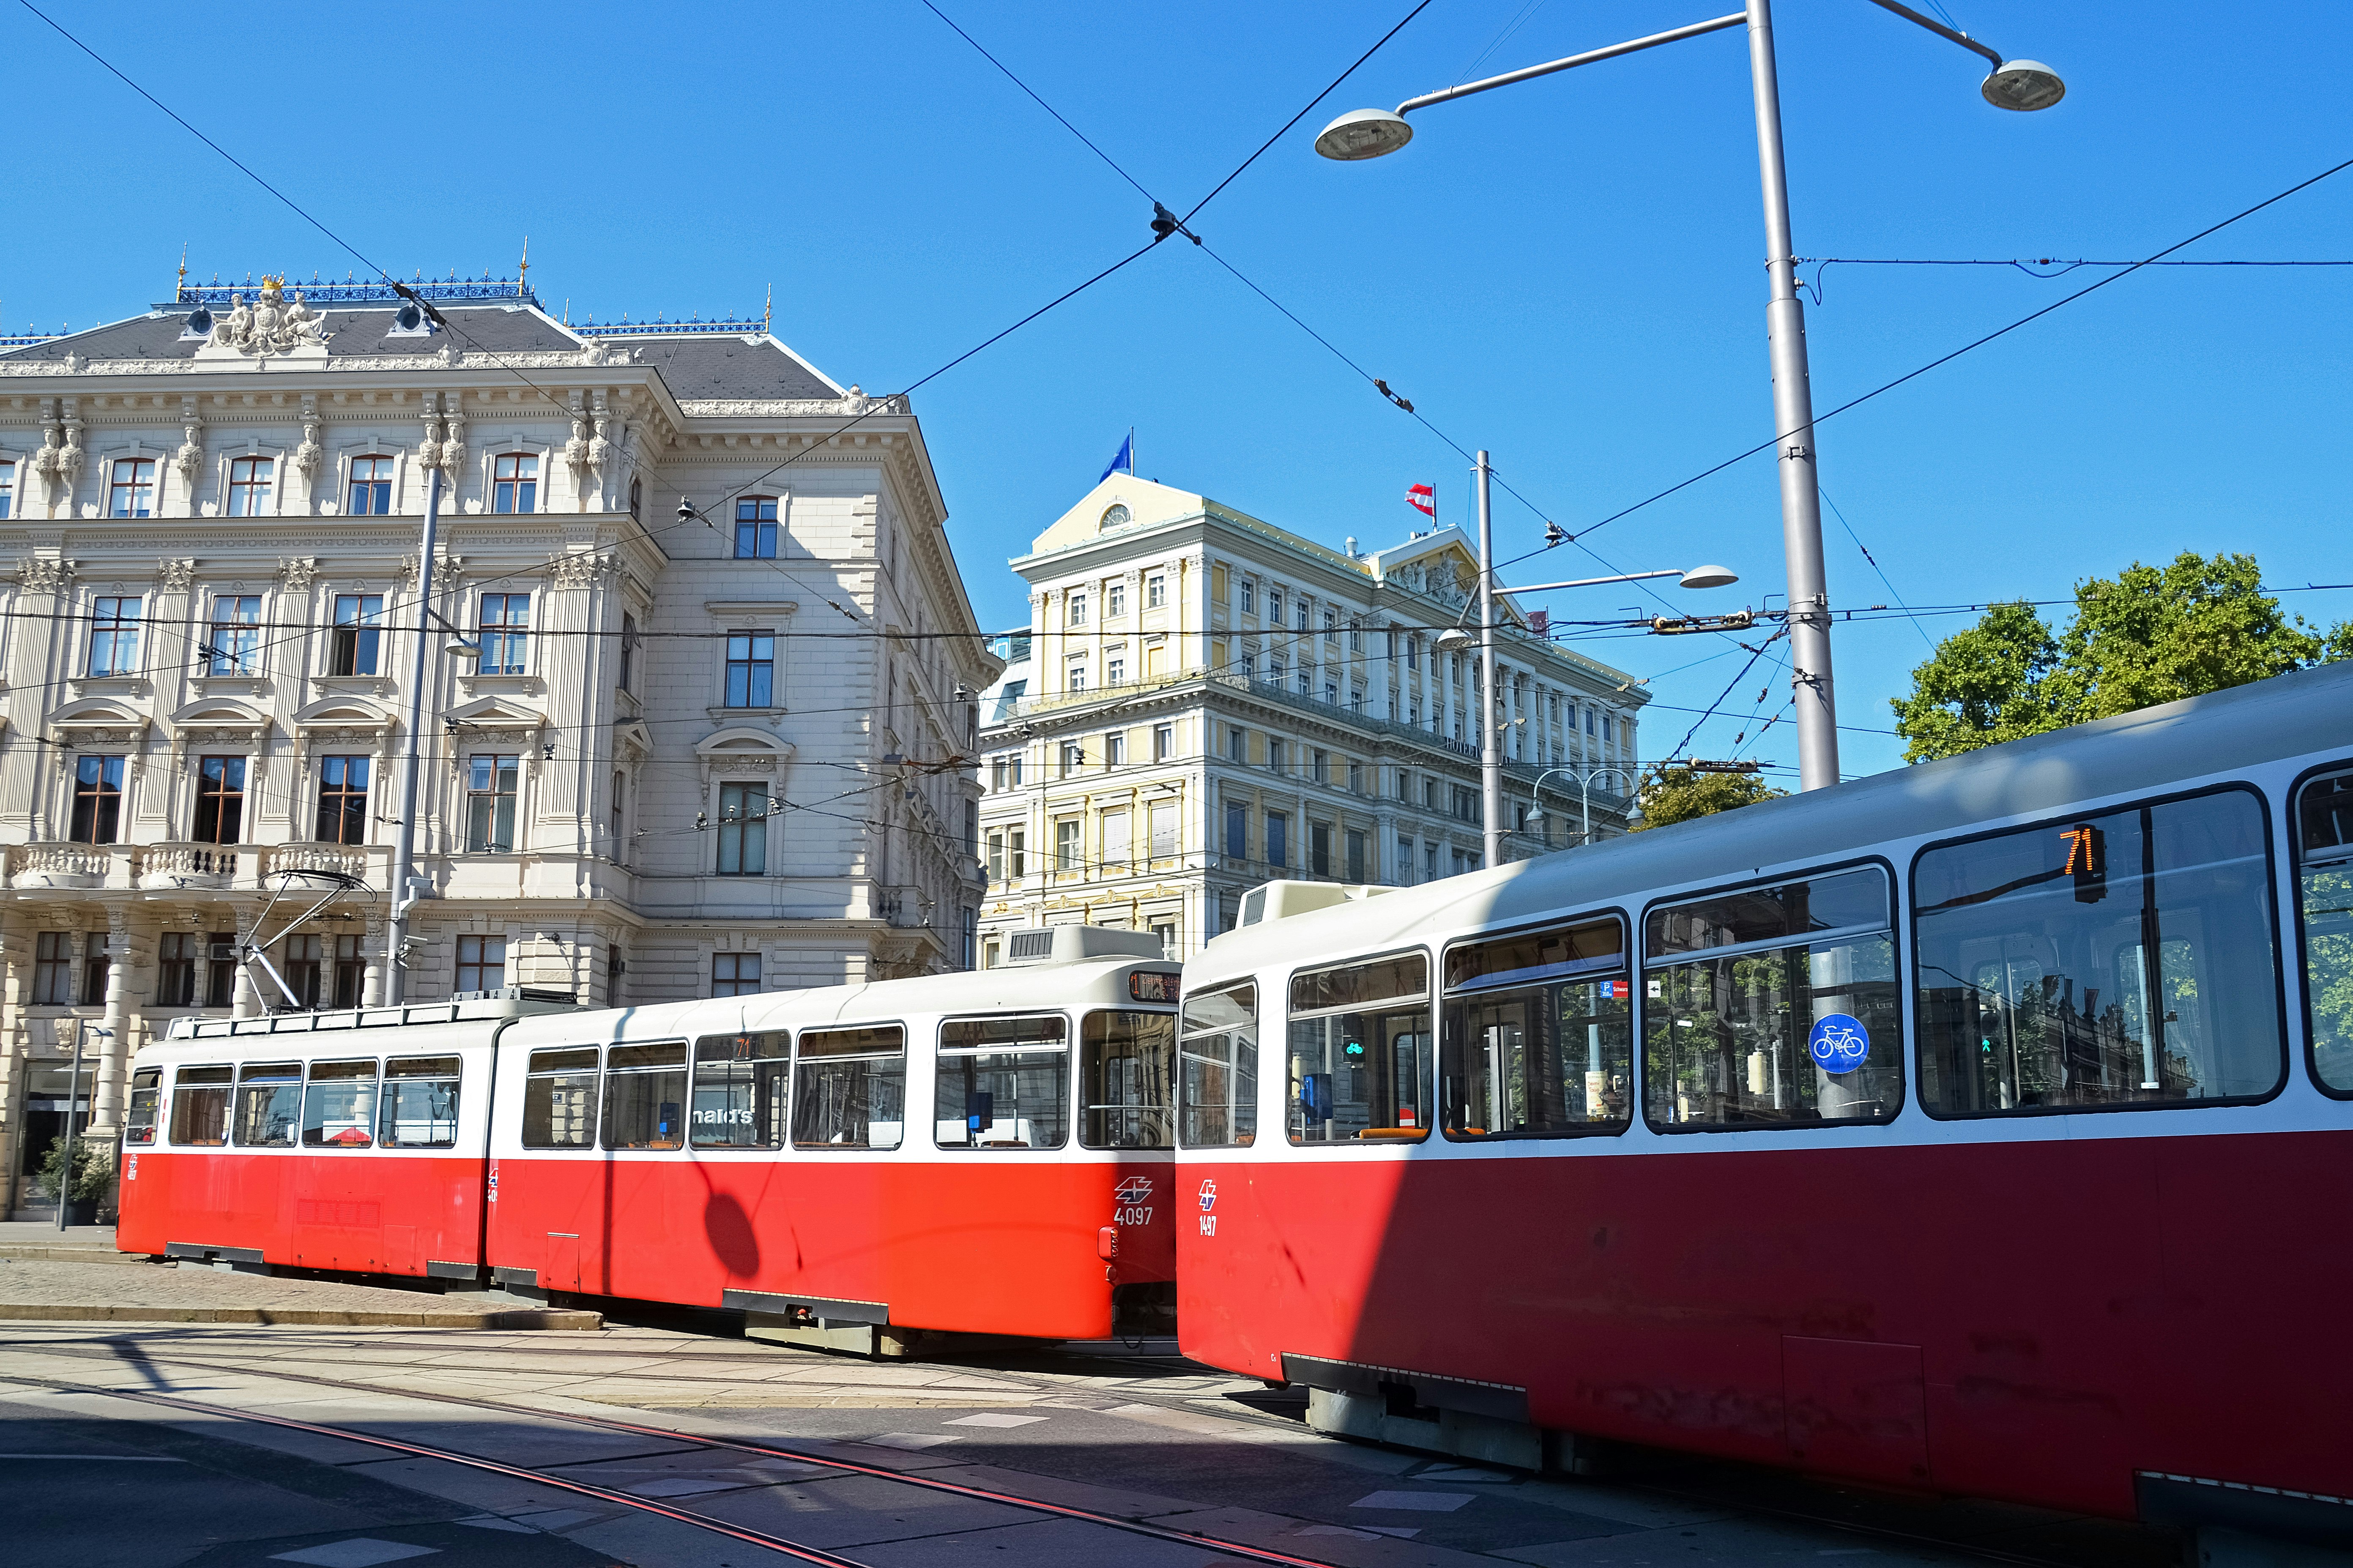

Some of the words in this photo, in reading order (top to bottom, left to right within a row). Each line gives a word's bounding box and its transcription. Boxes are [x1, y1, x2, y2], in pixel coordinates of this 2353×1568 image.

[1446, 737, 1474, 756] HOTEL
[2060, 828, 2093, 874] 71
[737, 1038, 749, 1057] 71
[693, 1109, 753, 1124] nald's
[1114, 1207, 1153, 1225] 4097
[1199, 1215, 1216, 1237] 1497
